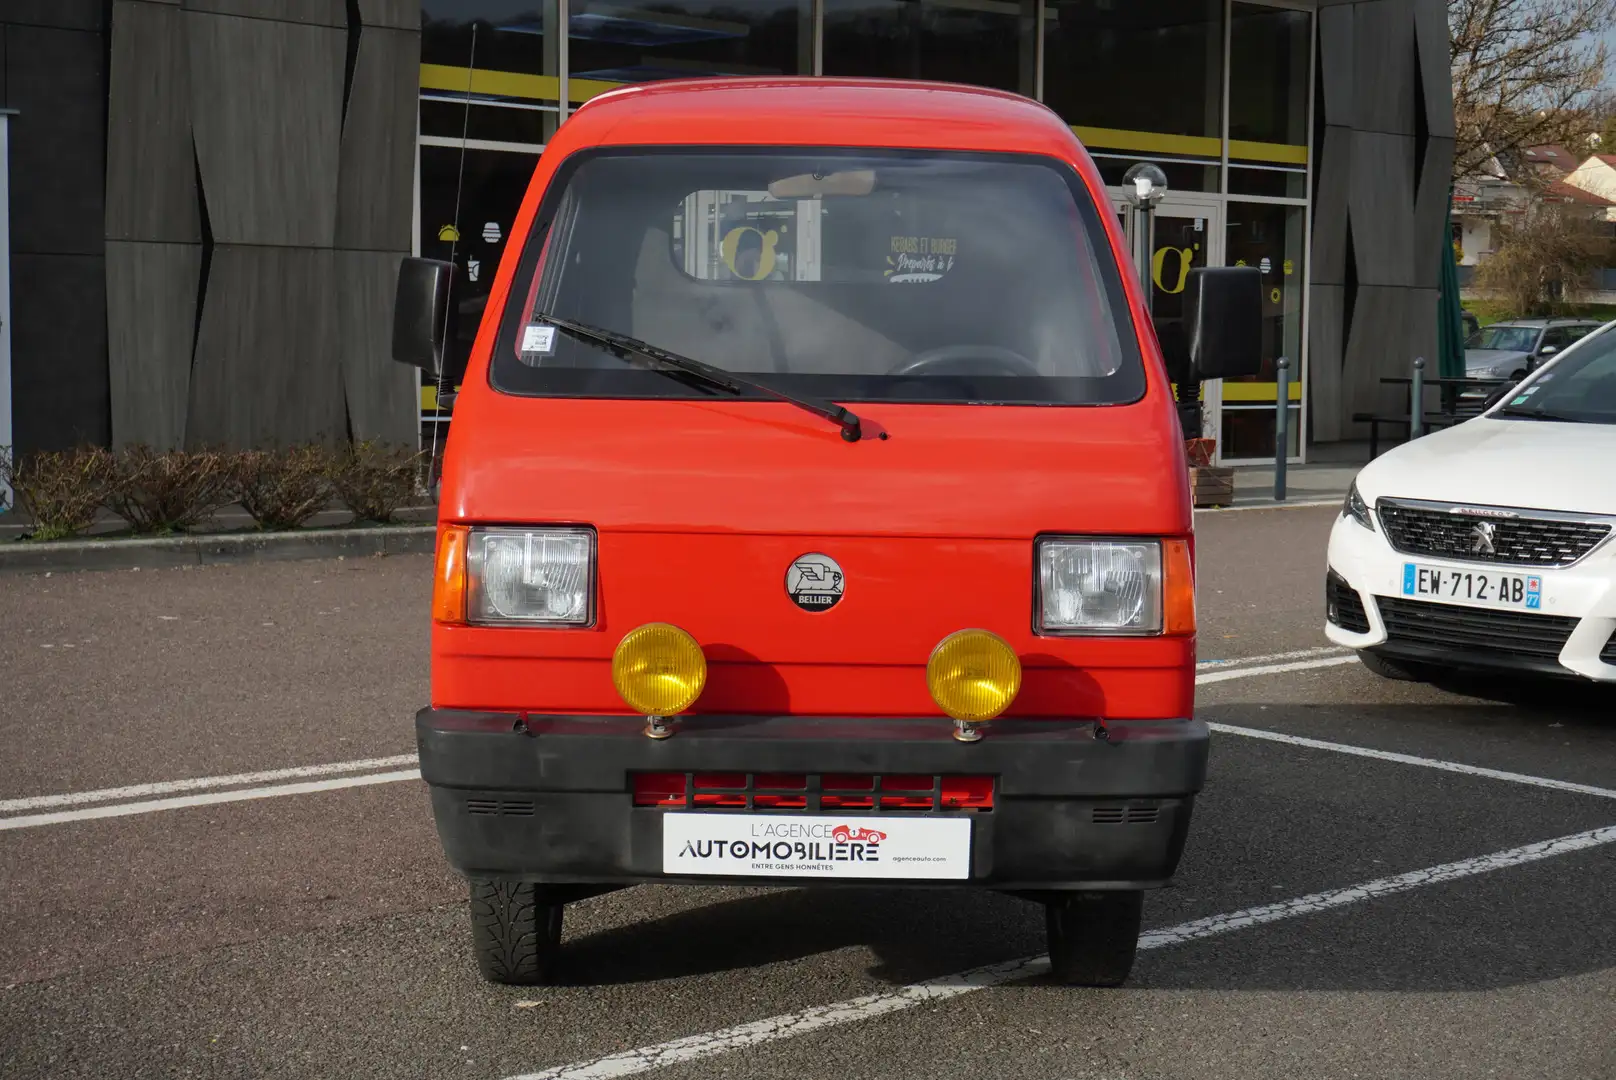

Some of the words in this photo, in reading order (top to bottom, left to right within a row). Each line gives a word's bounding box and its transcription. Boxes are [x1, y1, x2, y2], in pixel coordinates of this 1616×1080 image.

[920, 237, 929, 254] ET
[1418, 569, 1524, 603] EW-712-AB
[798, 595, 832, 604] BELLIER
[1526, 594, 1540, 606] 77
[751, 822, 833, 838] L'AGENCE
[892, 855, 947, 863] agenceauto.com
[775, 863, 795, 871] GENS
